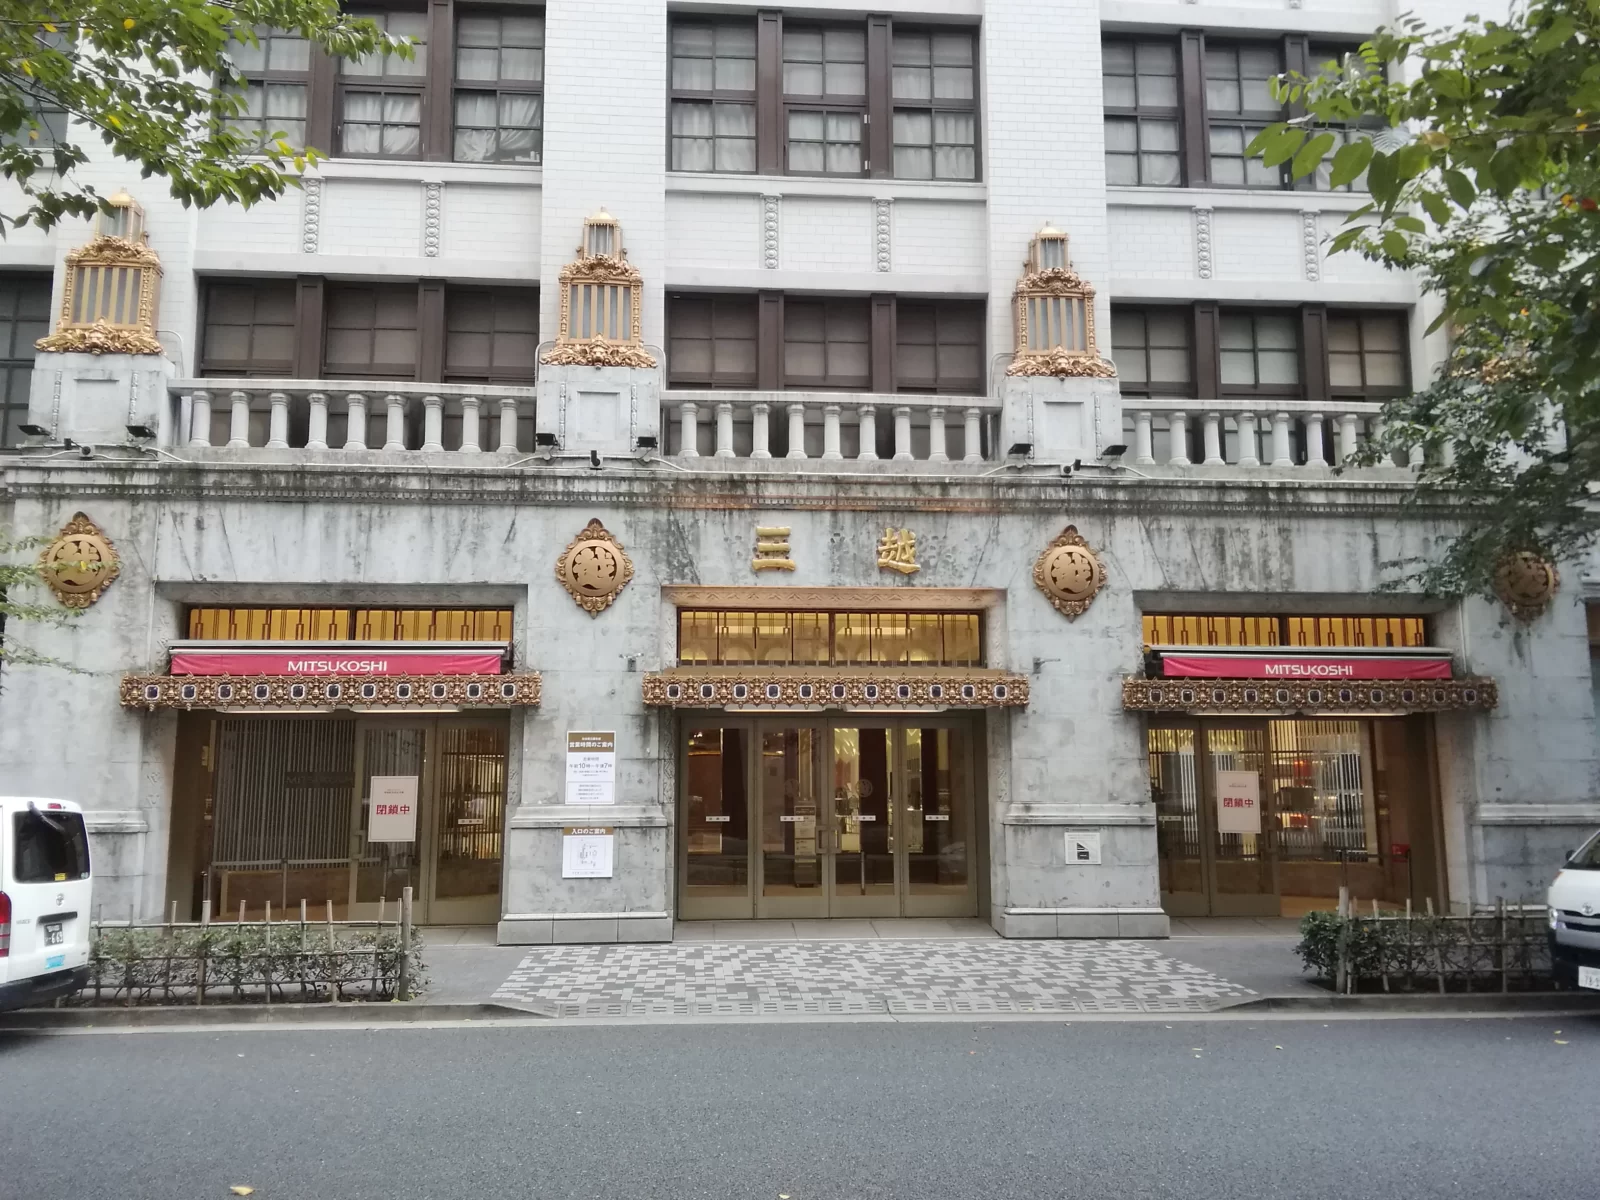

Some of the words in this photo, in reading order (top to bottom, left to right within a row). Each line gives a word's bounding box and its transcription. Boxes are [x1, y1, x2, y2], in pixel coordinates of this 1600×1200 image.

[752, 526, 921, 574] 三越
[287, 660, 388, 672] MITSUKOSHI
[1265, 664, 1353, 676] MITSUKOSHI
[1223, 797, 1254, 808] 閉鎖中
[376, 803, 411, 815] 閉鎖中
